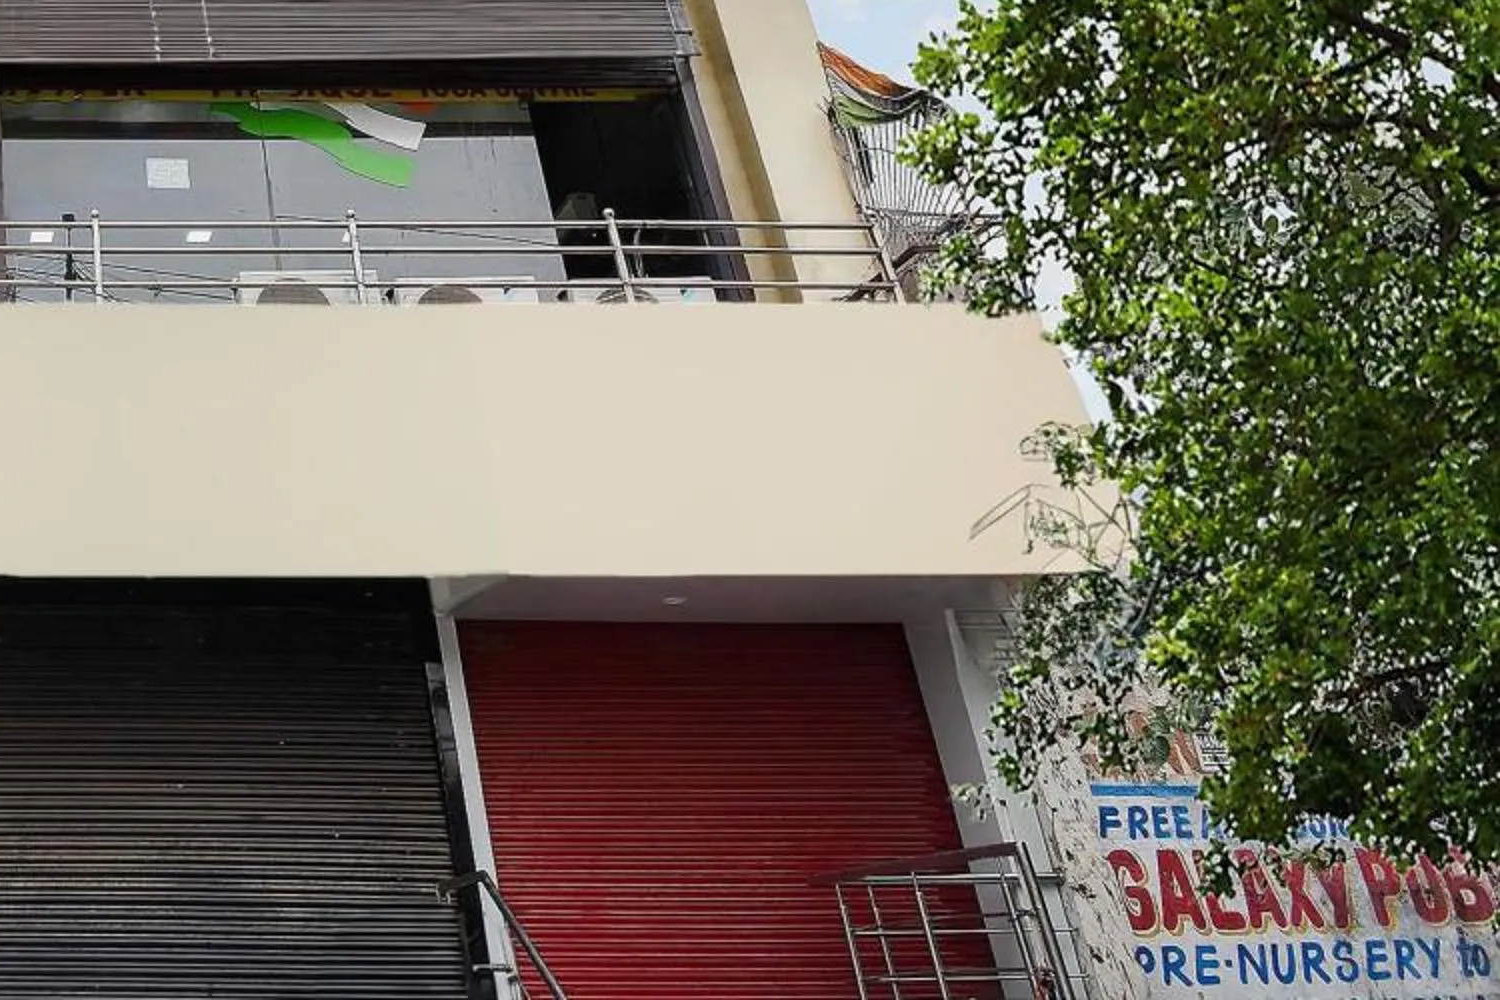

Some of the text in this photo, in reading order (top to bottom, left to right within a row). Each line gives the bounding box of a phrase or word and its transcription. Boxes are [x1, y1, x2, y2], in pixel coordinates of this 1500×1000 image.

[1097, 804, 1195, 841] FREE
[1105, 847, 1349, 933] GALAXY
[1456, 930, 1491, 978] to
